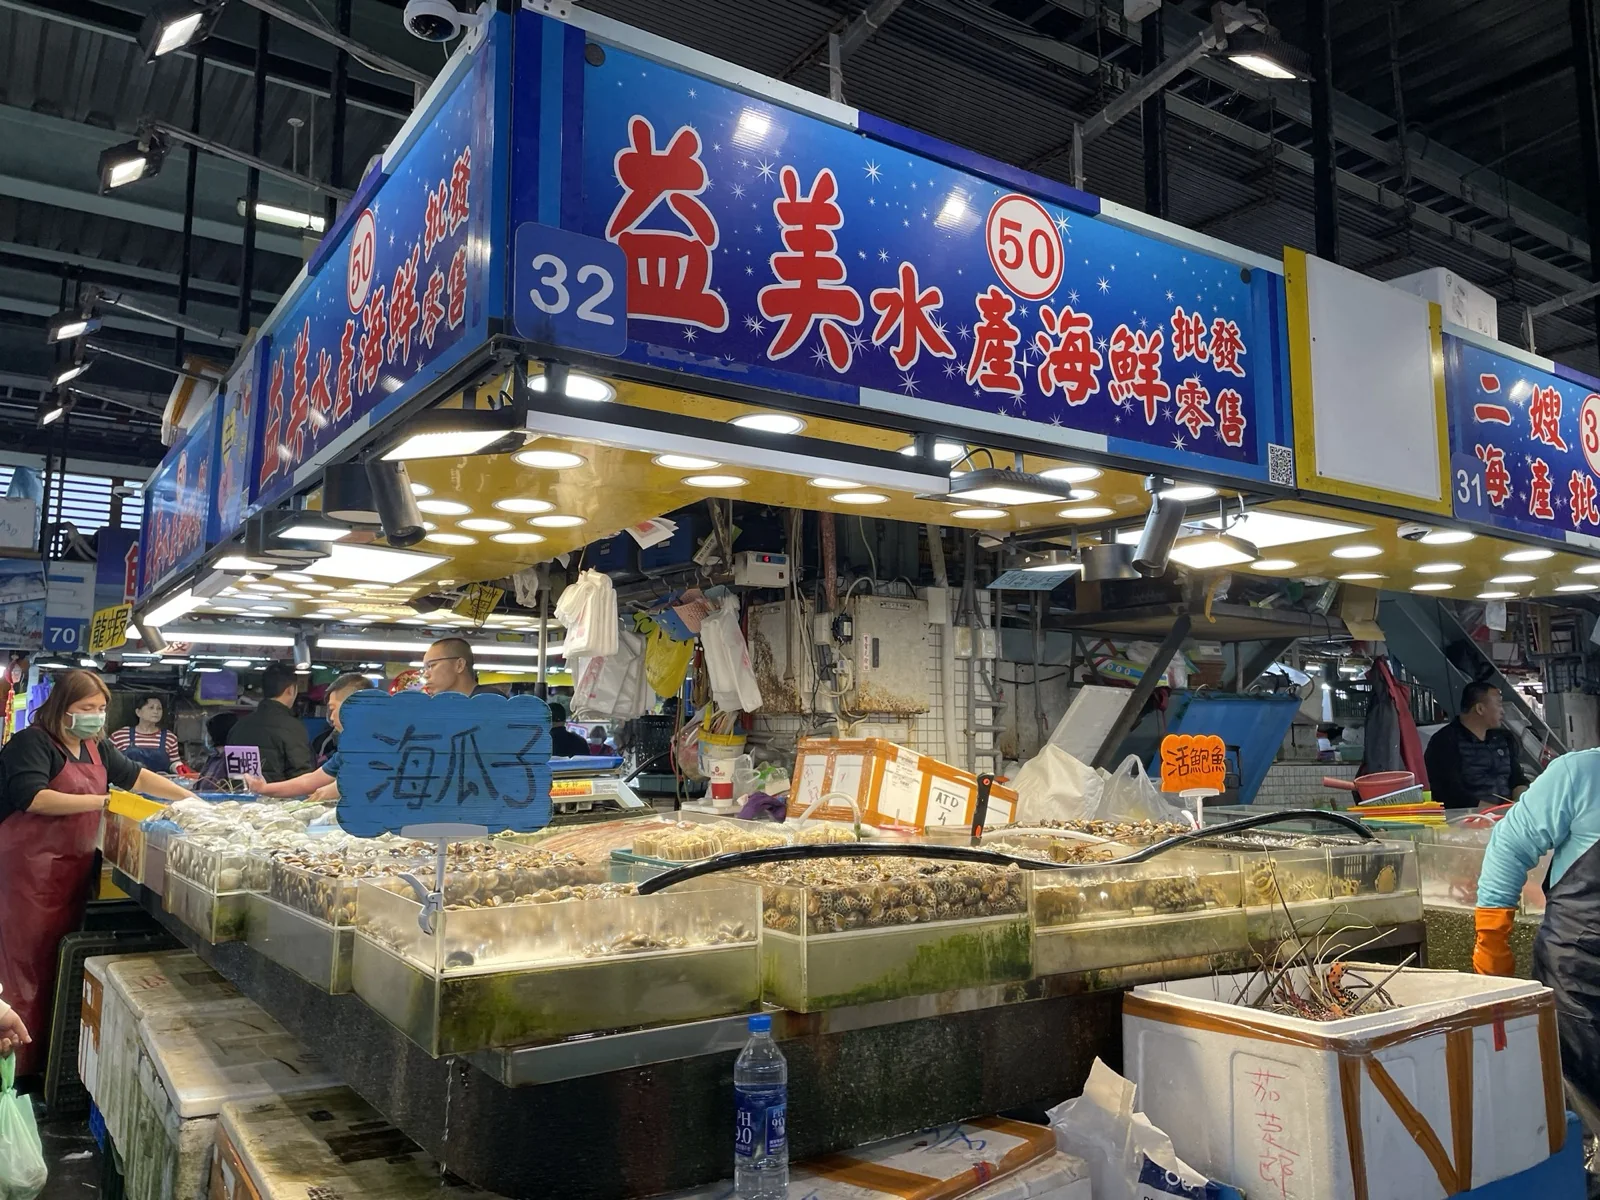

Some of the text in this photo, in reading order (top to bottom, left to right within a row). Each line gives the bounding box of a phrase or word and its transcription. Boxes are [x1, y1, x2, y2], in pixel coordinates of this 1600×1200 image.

[424, 145, 471, 263] 批發
[350, 230, 374, 296] 50
[605, 114, 1171, 426] 益美水產海鮮
[998, 217, 1056, 280] 50
[420, 245, 468, 349] 零售
[529, 253, 615, 326] 32
[259, 242, 420, 488] 益美水產海鮮
[1171, 305, 1247, 379] 批發
[1174, 378, 1247, 448] 零售
[1474, 374, 1568, 453] 二嫂
[1457, 469, 1482, 507] 31
[50, 627, 75, 644] 70
[227, 751, 259, 777] 白蝦
[366, 725, 547, 810] 海瓜子
[1166, 745, 1224, 777] 活鮑魚
[935, 791, 960, 808] ATD
